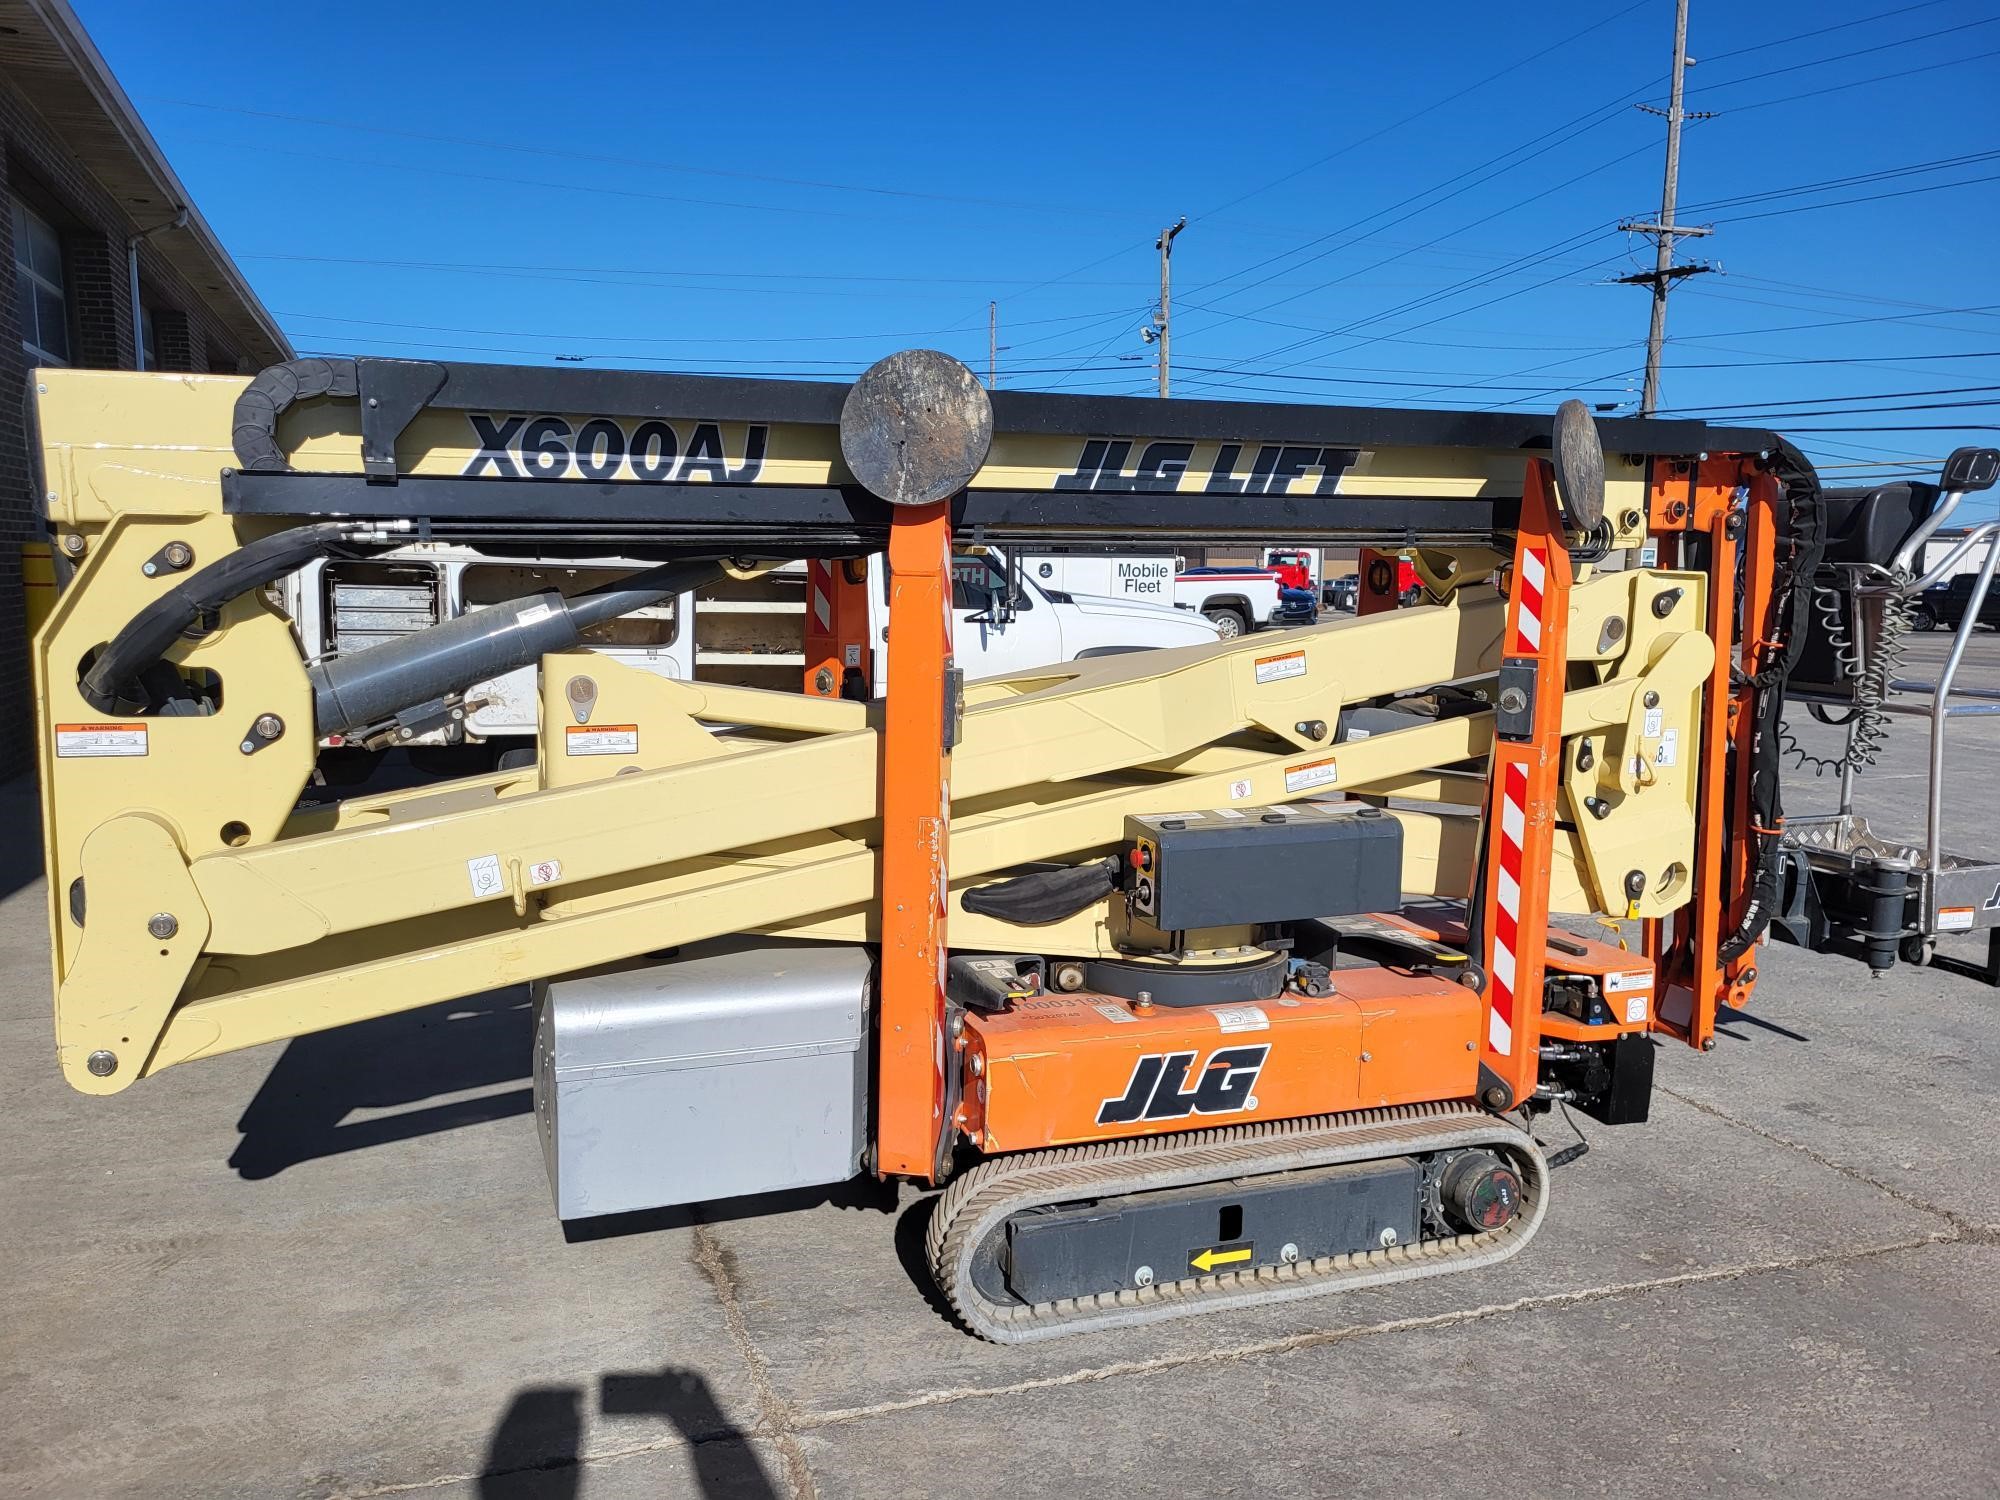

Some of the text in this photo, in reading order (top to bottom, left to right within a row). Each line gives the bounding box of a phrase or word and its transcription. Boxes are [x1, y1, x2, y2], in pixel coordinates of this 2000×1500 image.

[460, 412, 771, 481] X600AJ
[1053, 438, 1374, 494] JLG LIFT
[1118, 562, 1169, 578] Mobile
[1125, 578, 1162, 593] Fleet
[1094, 1043, 1273, 1127] JLG
